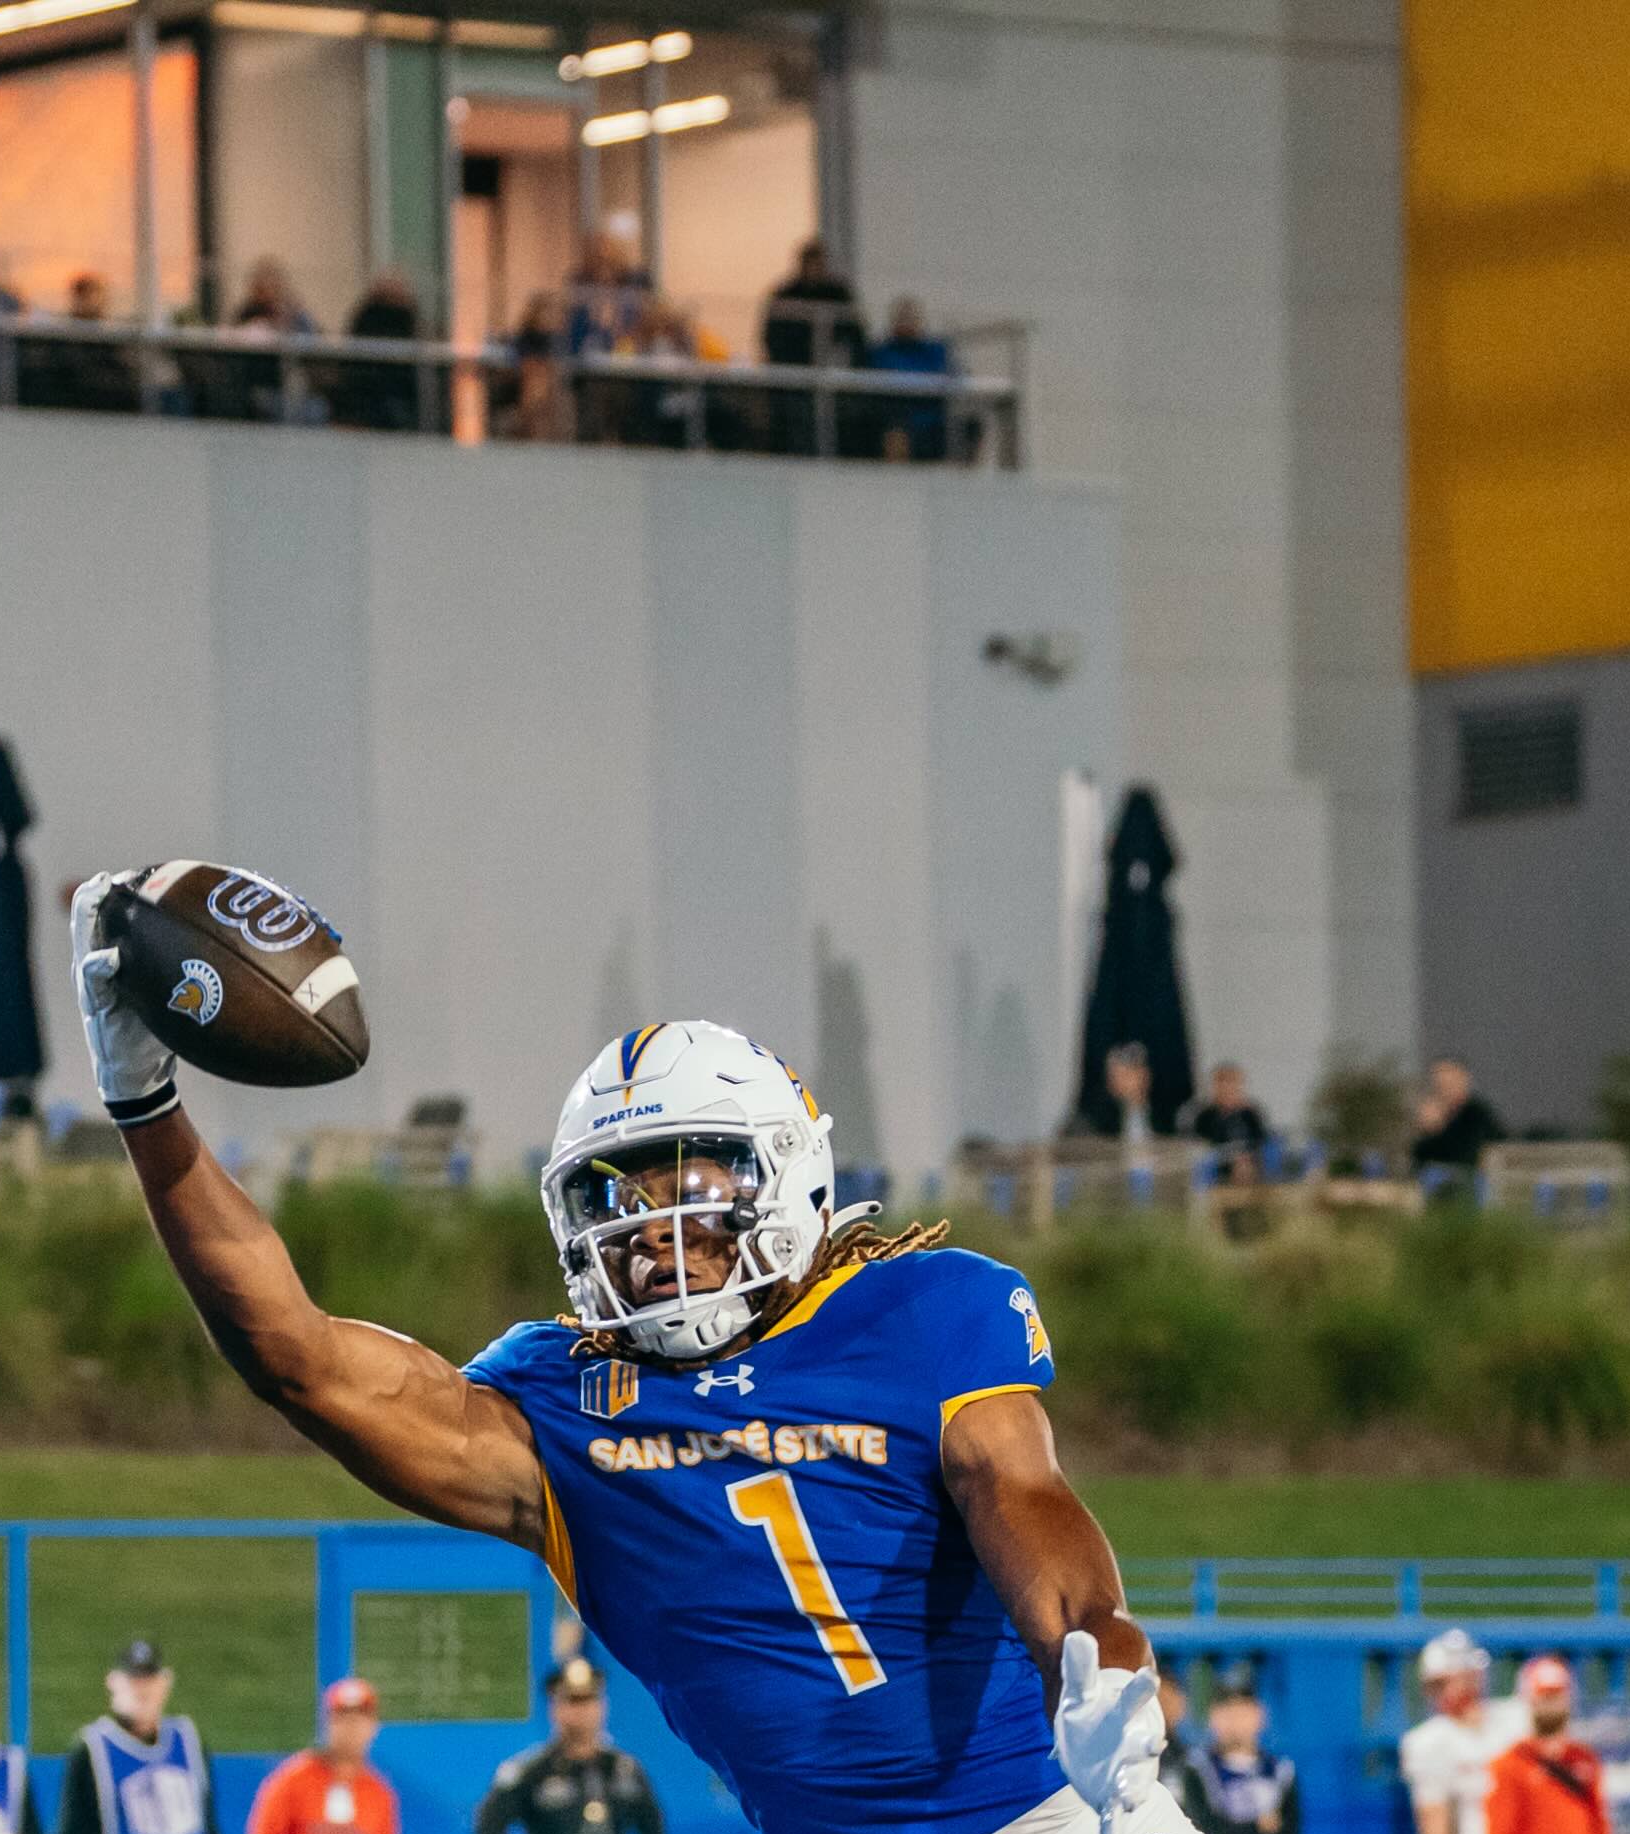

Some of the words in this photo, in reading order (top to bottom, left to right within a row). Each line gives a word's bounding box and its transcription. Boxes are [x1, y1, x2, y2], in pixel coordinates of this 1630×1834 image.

[593, 1103, 664, 1130] SPARTANS
[589, 1437, 675, 1473] SAN
[773, 1423, 889, 1466] STATE
[724, 1468, 889, 1697] 1
